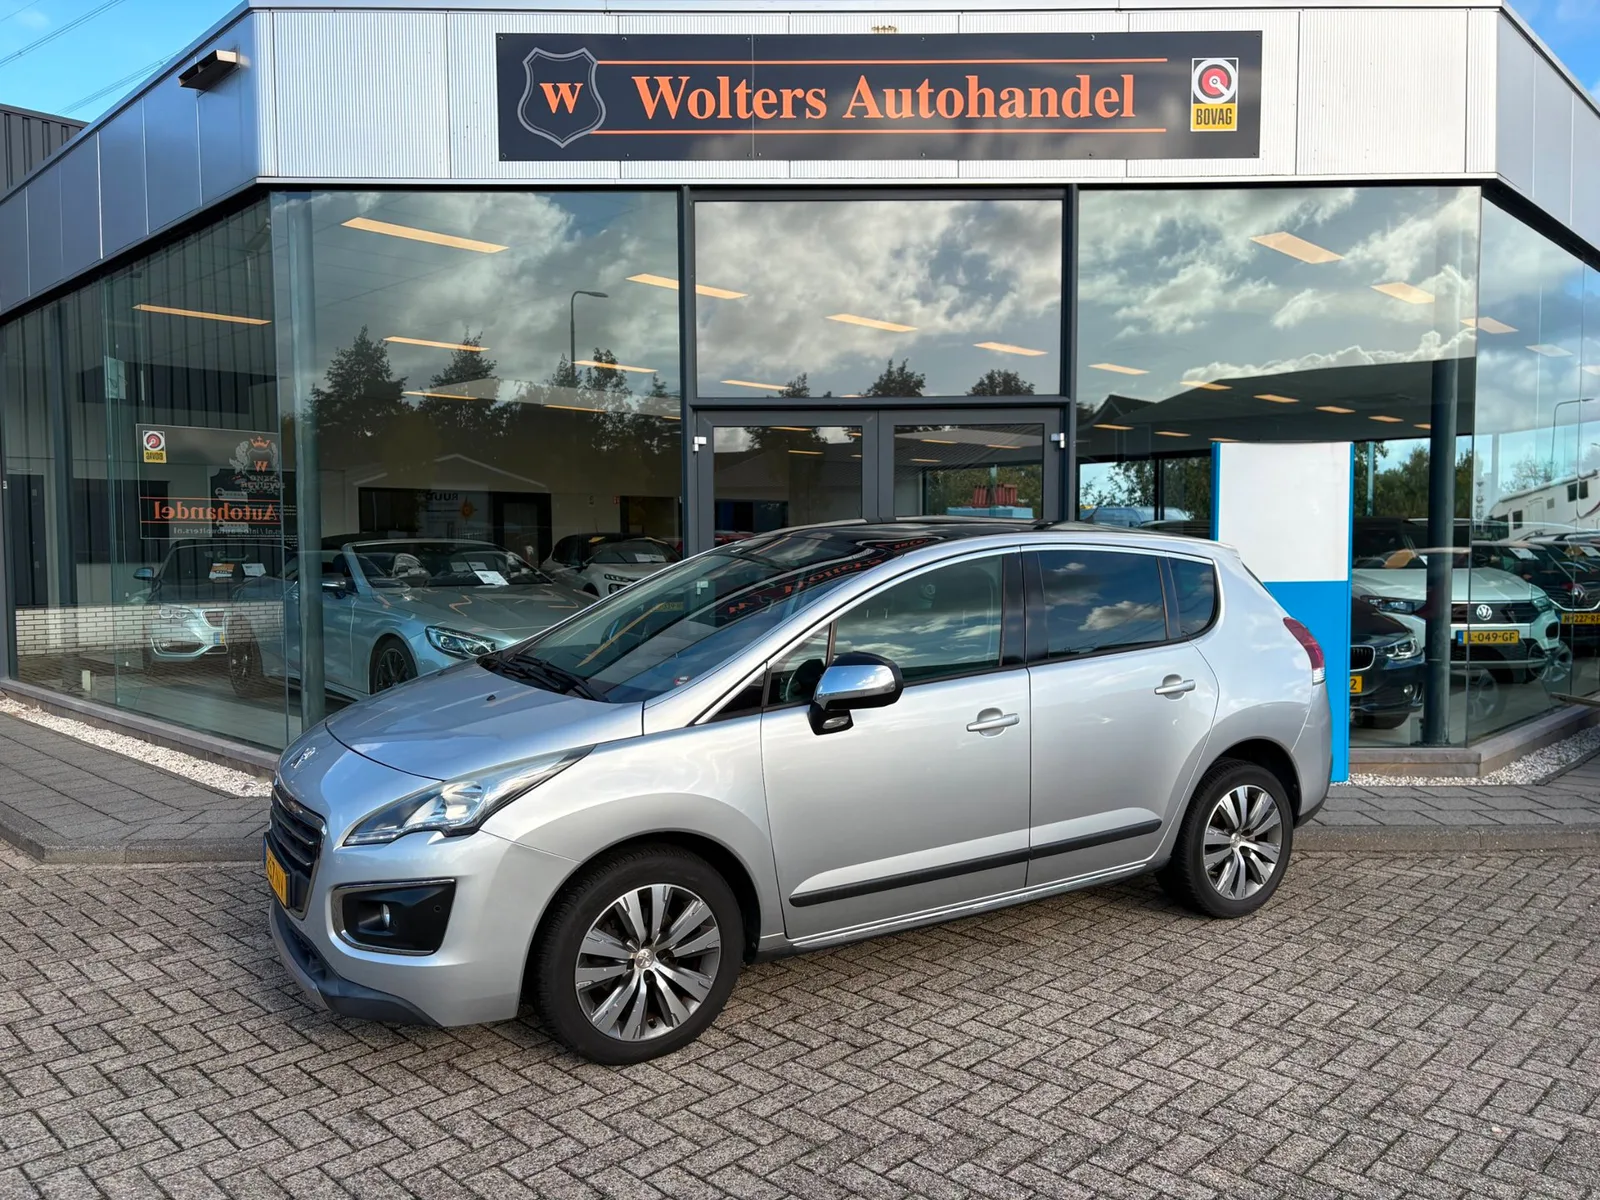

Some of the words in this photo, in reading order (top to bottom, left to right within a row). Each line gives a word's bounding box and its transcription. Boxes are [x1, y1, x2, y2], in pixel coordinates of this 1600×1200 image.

[541, 83, 582, 113] W
[633, 75, 828, 121] Wolters
[844, 73, 1136, 120] Autohandel
[1196, 108, 1232, 125] BOVAG
